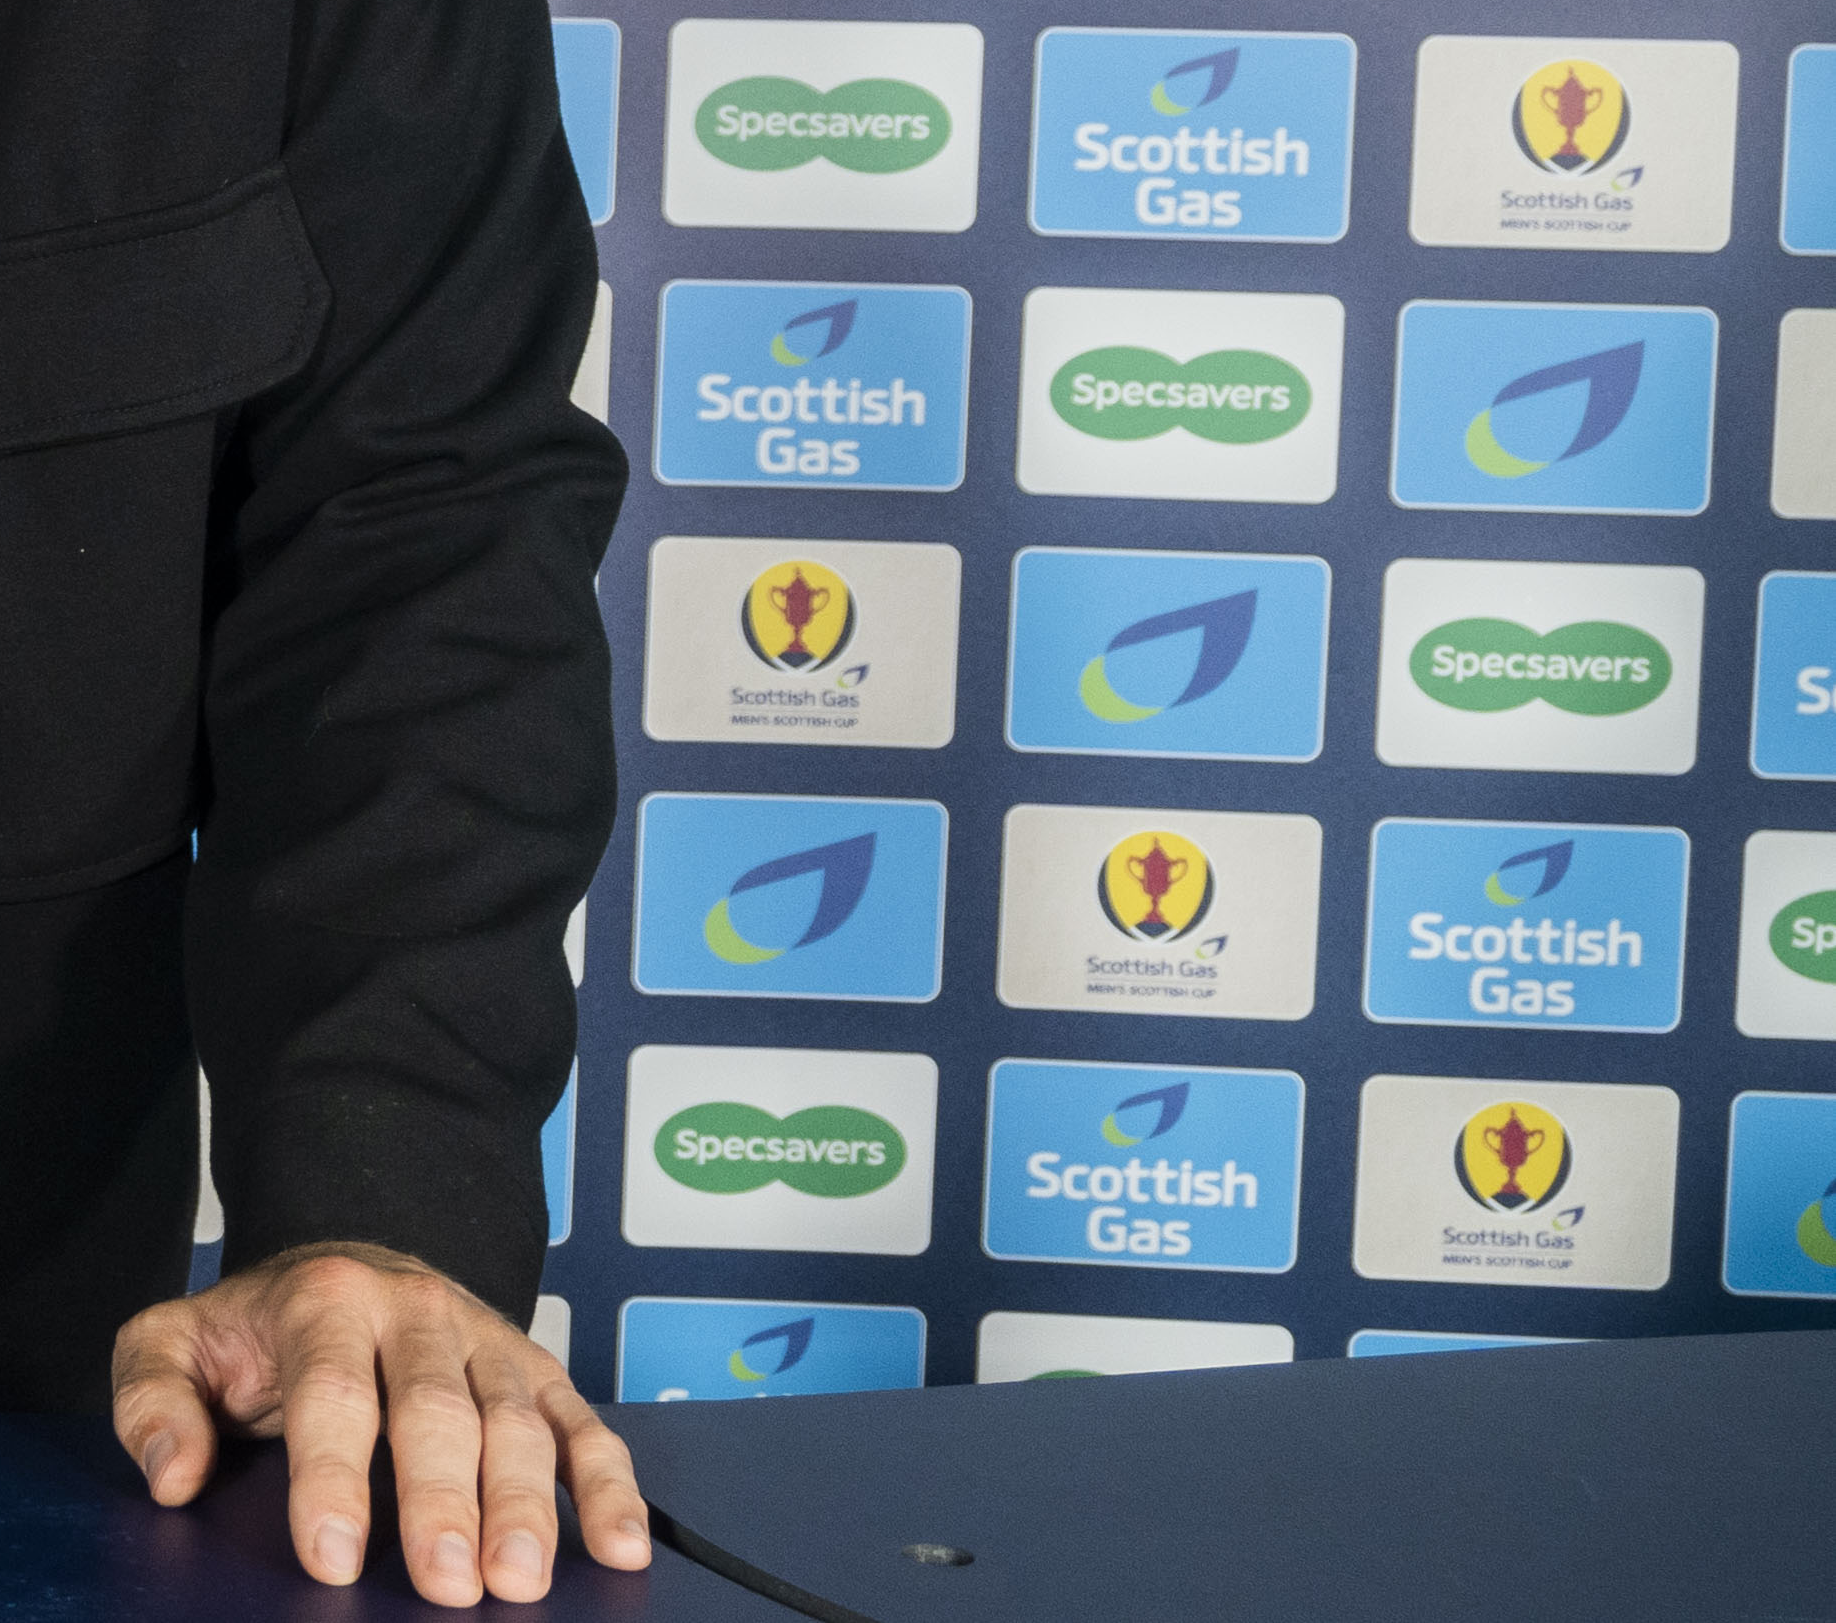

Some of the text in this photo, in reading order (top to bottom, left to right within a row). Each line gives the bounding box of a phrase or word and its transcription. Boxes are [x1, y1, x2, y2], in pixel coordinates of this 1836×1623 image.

[715, 104, 931, 142] Specsavers
[1072, 121, 1311, 178] Scottish
[1133, 175, 1244, 229] Gas
[1500, 190, 1634, 213] Scottish Gas
[695, 371, 928, 427] Scottish
[1072, 372, 1292, 412] Specsavers
[754, 425, 862, 477] Gas
[1431, 644, 1652, 684] Specsavers
[730, 687, 860, 709] Scottish Gas
[1406, 909, 1644, 969] Scottish
[1086, 956, 1219, 980] Scottish Gas
[1467, 964, 1577, 1018] Gas
[674, 1128, 886, 1167] Specsavers
[1025, 1150, 1260, 1210] Scottish
[1085, 1204, 1193, 1258] Gas
[1442, 1227, 1575, 1251] Scottish Gas
